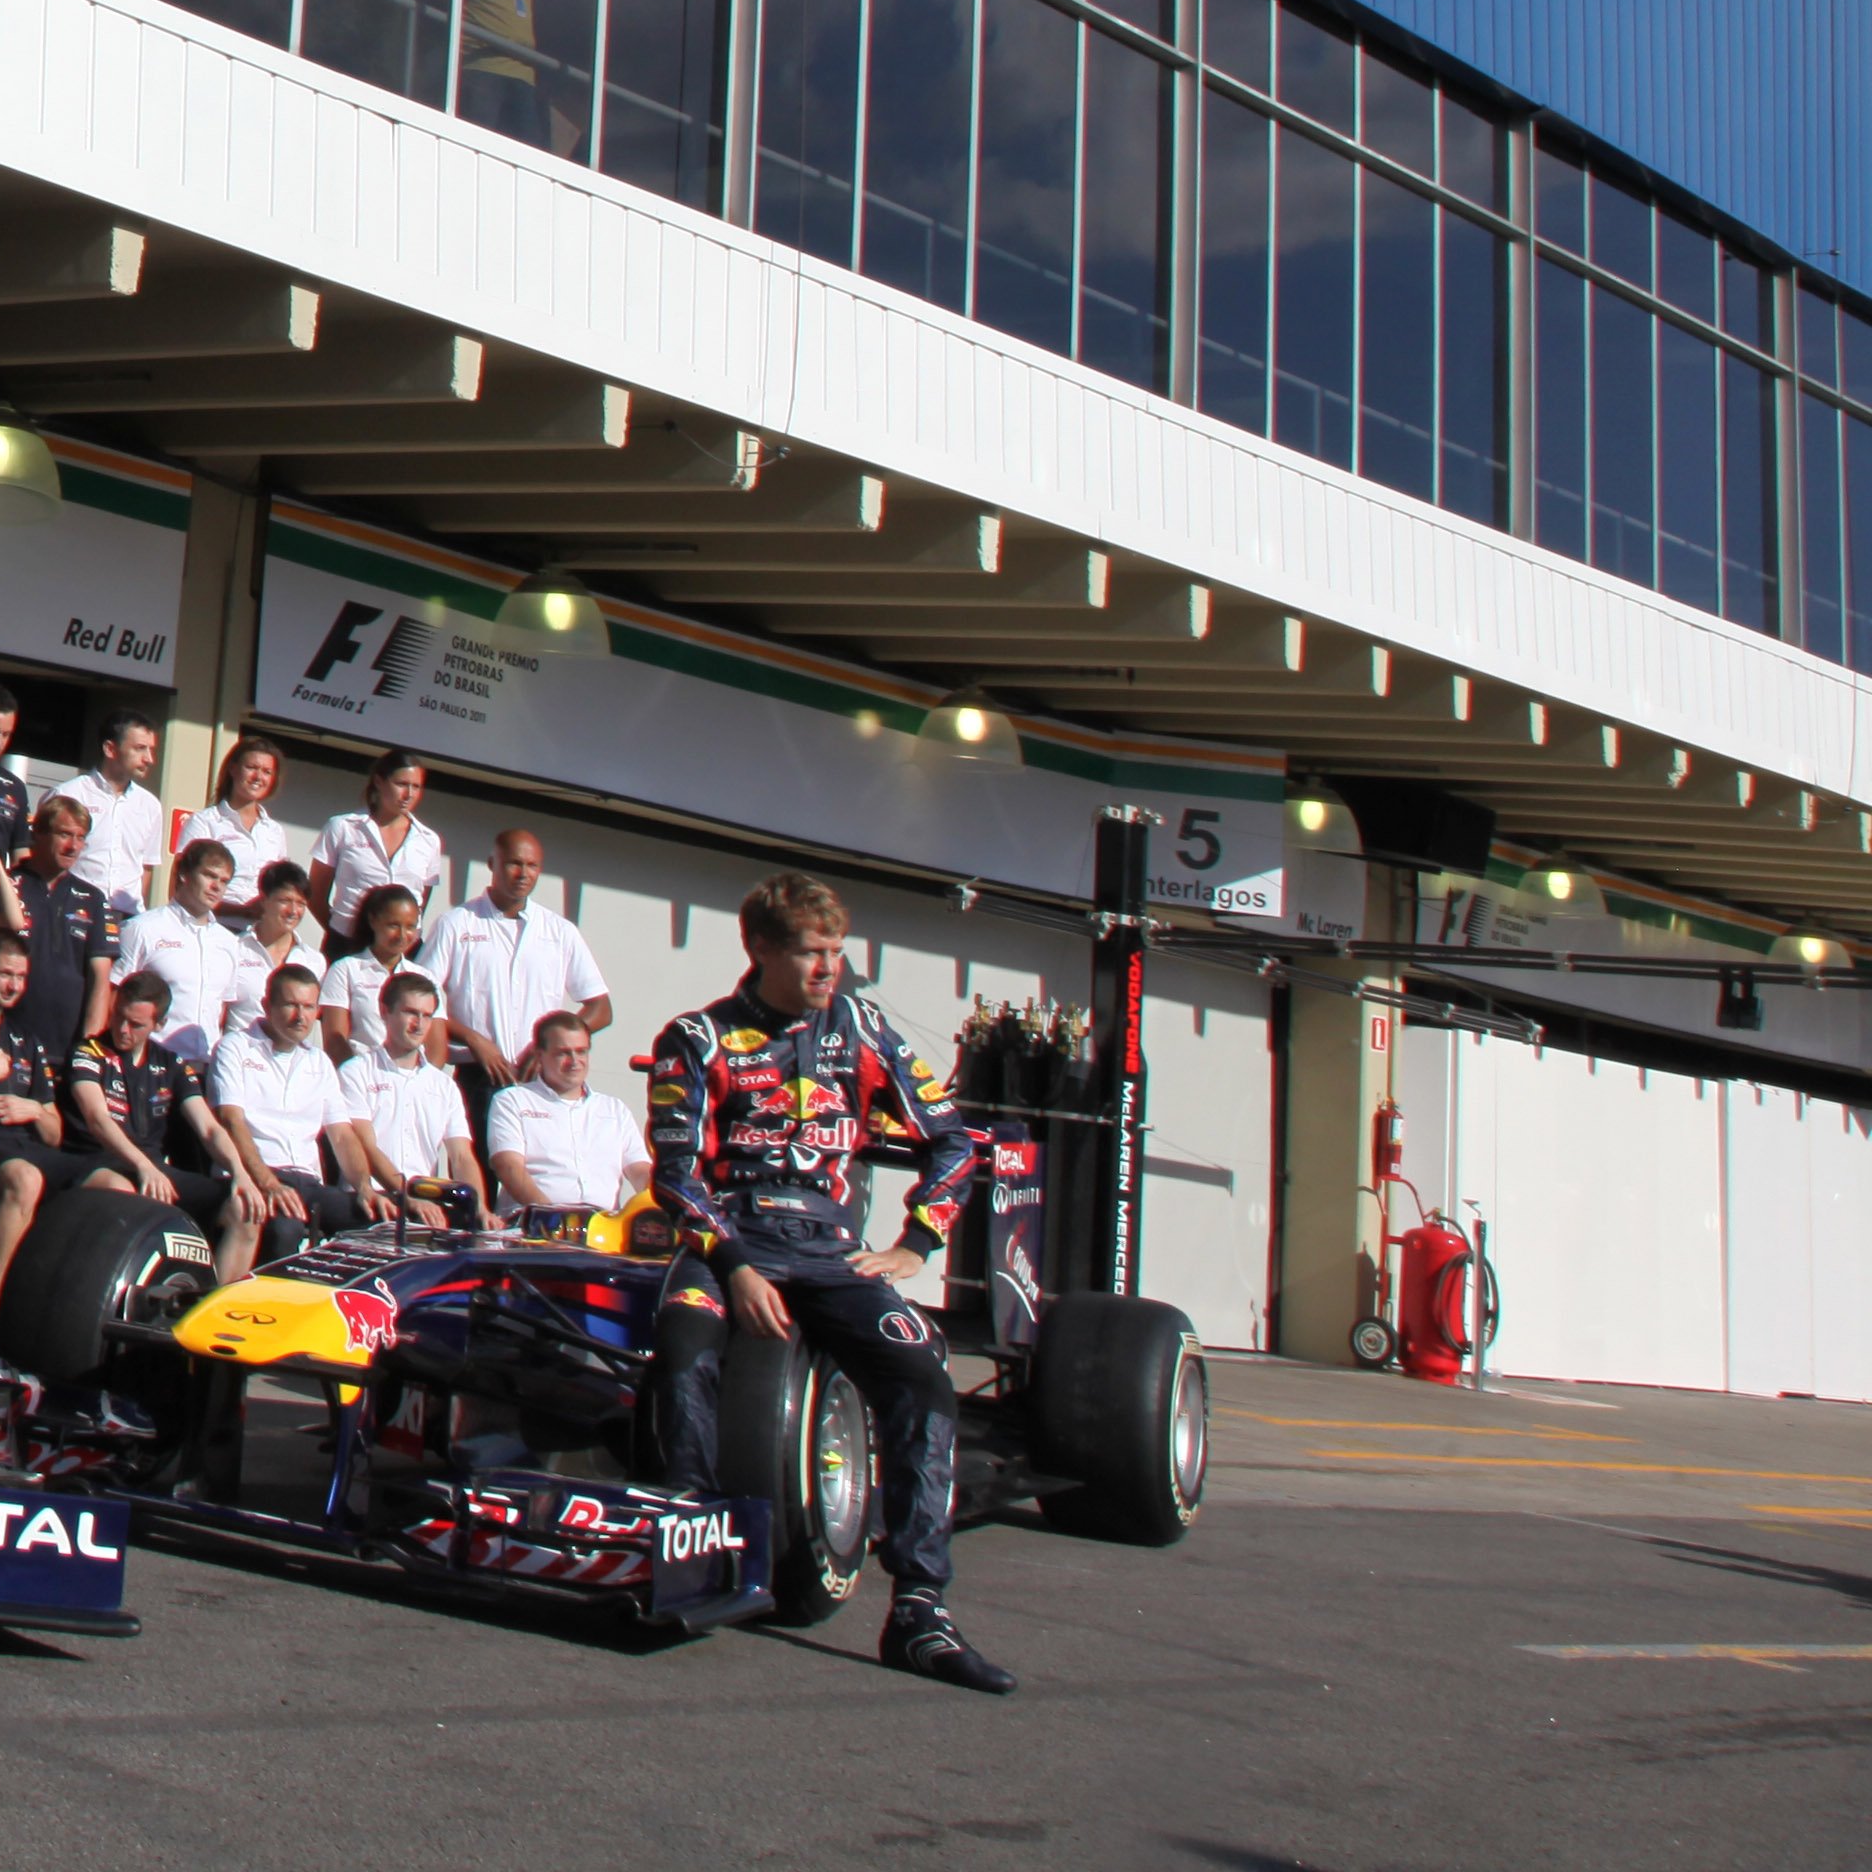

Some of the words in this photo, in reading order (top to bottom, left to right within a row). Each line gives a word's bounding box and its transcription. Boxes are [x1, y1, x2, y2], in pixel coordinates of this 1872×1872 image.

[63, 618, 113, 657] Red
[118, 629, 165, 664] Bull
[452, 636, 494, 660] GRANDE
[444, 653, 504, 682] PETROBRAS
[434, 670, 451, 687] DO
[455, 676, 490, 698] BRASIL
[292, 684, 352, 712] Formula
[356, 700, 366, 715] 1
[440, 702, 467, 719] PAULO
[470, 710, 486, 724] 2011
[1176, 808, 1221, 870] 5
[1146, 878, 1267, 910] nterlagos
[1296, 911, 1314, 934] Mc
[1317, 915, 1353, 940] Laren
[1125, 951, 1142, 1074] VODAFONE
[727, 1052, 773, 1067] GEOX
[801, 1117, 857, 1150] Bull
[993, 1145, 1025, 1170] TOTAL
[658, 1510, 744, 1562] TOTAL
